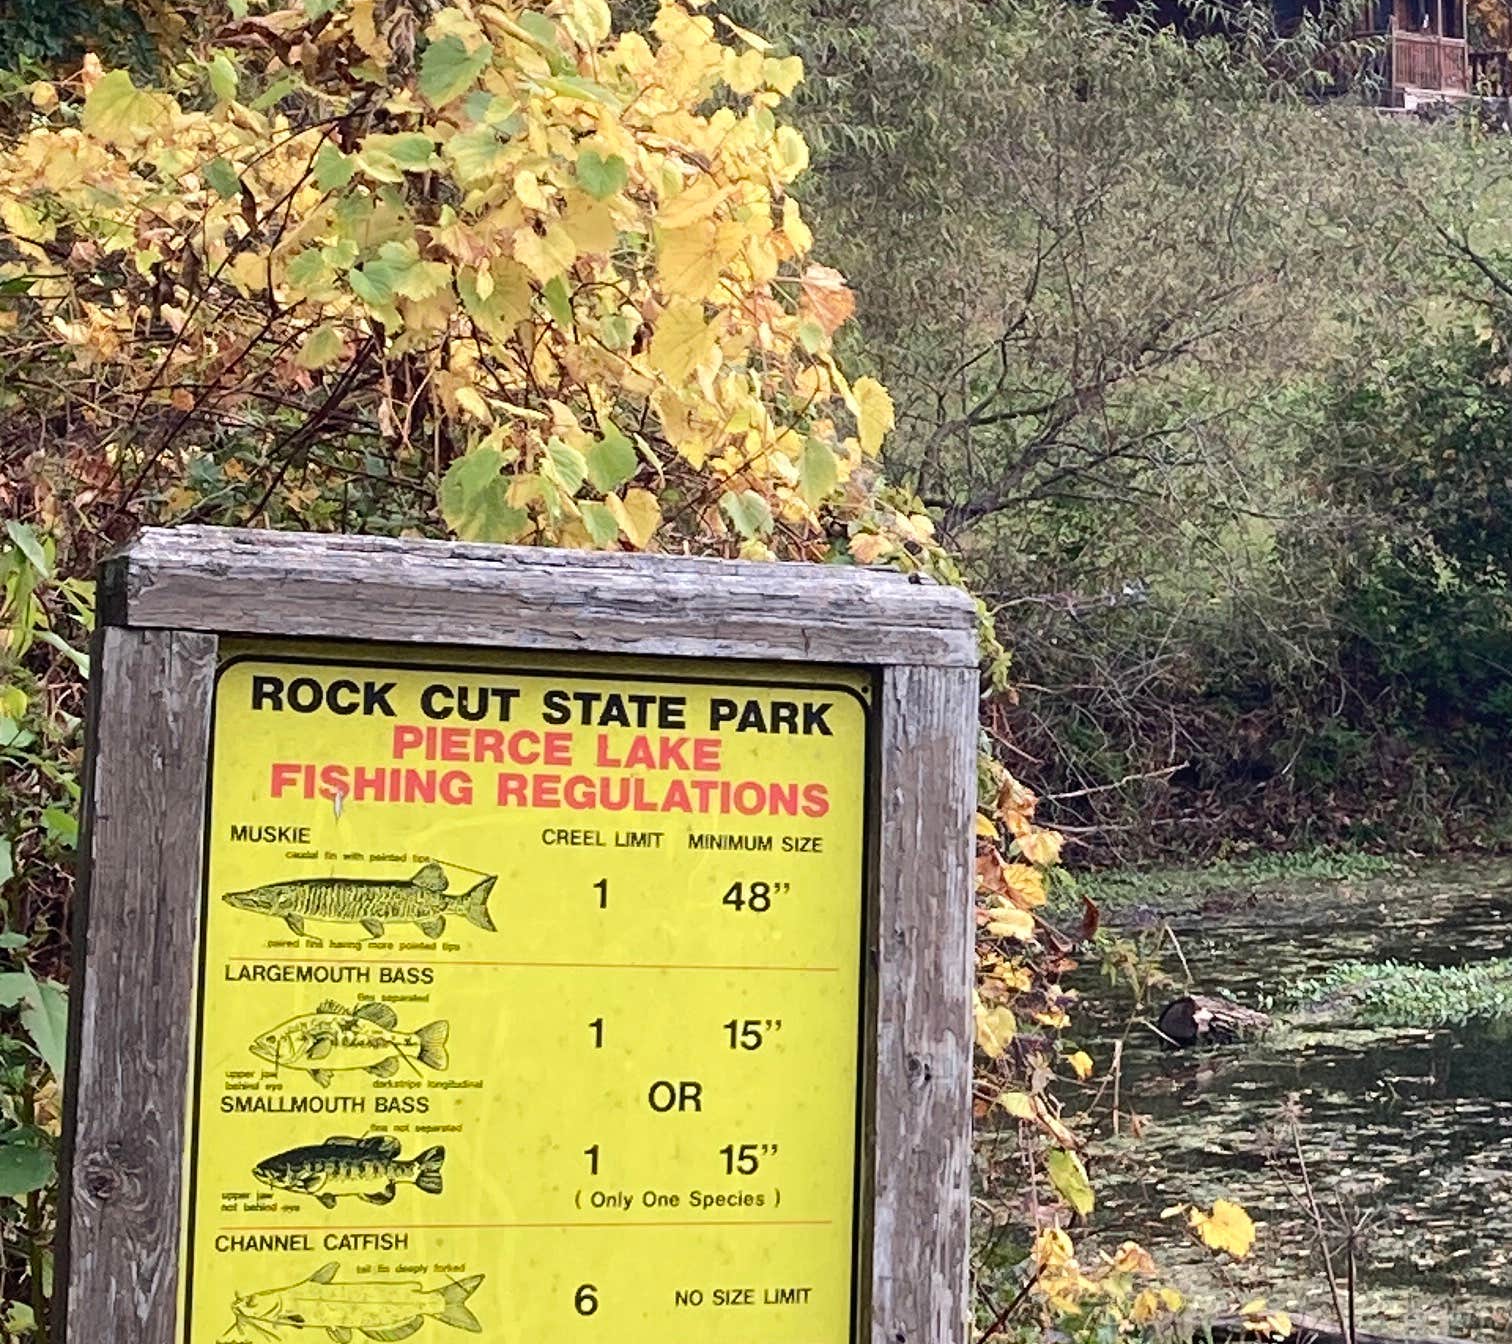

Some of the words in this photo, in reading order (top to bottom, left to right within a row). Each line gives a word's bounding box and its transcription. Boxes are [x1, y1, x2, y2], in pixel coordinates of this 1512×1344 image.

[252, 675, 397, 717] ROCK
[421, 684, 520, 722] CUT
[542, 690, 686, 730] STATE
[710, 698, 833, 736] PARK
[393, 724, 572, 766] PIERCE
[597, 733, 722, 772] LAKE
[271, 763, 473, 806] FISHING
[497, 772, 830, 818] REGULATIONS
[230, 825, 311, 844] MUSKIE
[542, 829, 606, 847] CREEL
[615, 831, 665, 848] LIMIT
[688, 833, 772, 852] MINIMUM
[781, 836, 823, 853] SIZE
[593, 878, 607, 909] 1
[225, 965, 370, 983] LARGEMOUTH
[379, 967, 434, 984] BASS
[588, 1018, 603, 1049] 1
[220, 1096, 365, 1114] SMALLMOUTH
[374, 1096, 429, 1114] BASS
[648, 1080, 703, 1112] OR
[584, 1144, 599, 1175] 1
[642, 1191, 680, 1207] One
[215, 1234, 314, 1252] CHANNEL
[323, 1233, 408, 1251] CATFISH
[574, 1284, 598, 1316] 6
[675, 1289, 703, 1306] NO
[713, 1288, 755, 1306] SIZE
[764, 1288, 812, 1304] LIMIT
